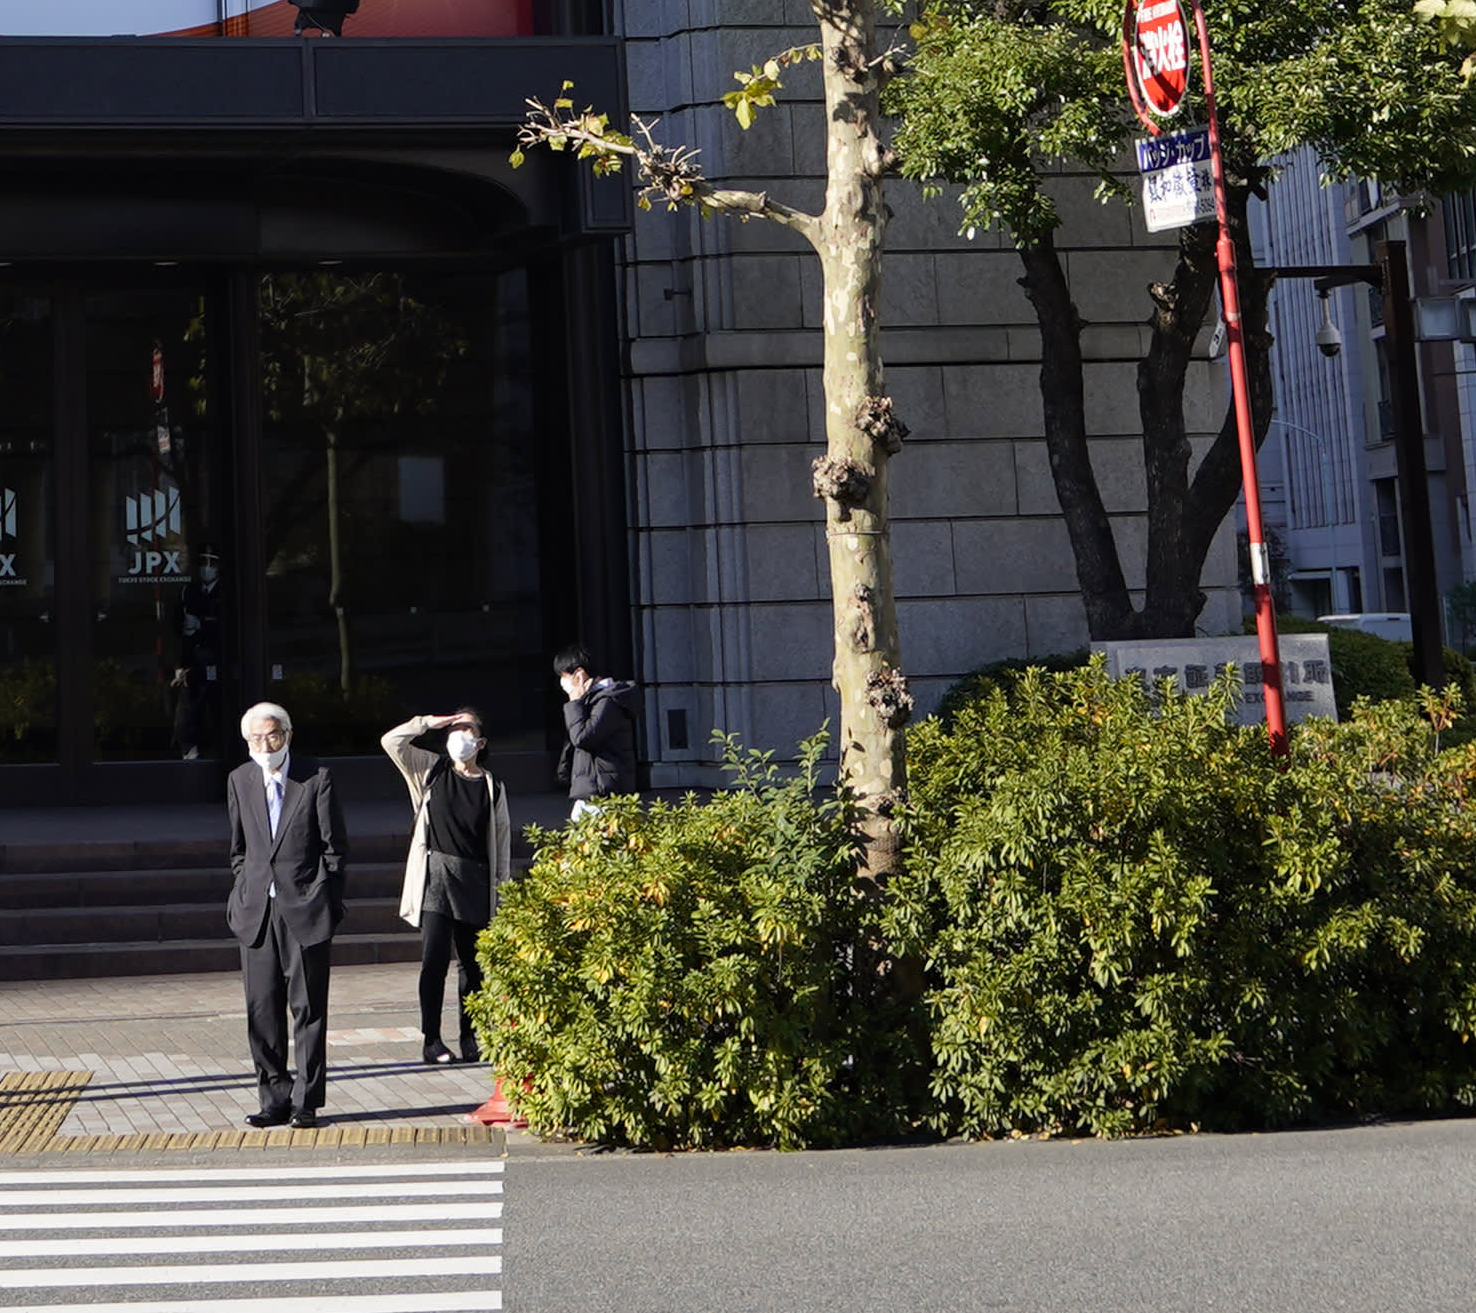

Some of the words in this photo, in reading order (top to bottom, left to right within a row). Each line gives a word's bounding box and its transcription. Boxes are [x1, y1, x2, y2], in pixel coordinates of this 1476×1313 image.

[1139, 19, 1186, 80] 消火栓
[128, 550, 182, 575] JPX
